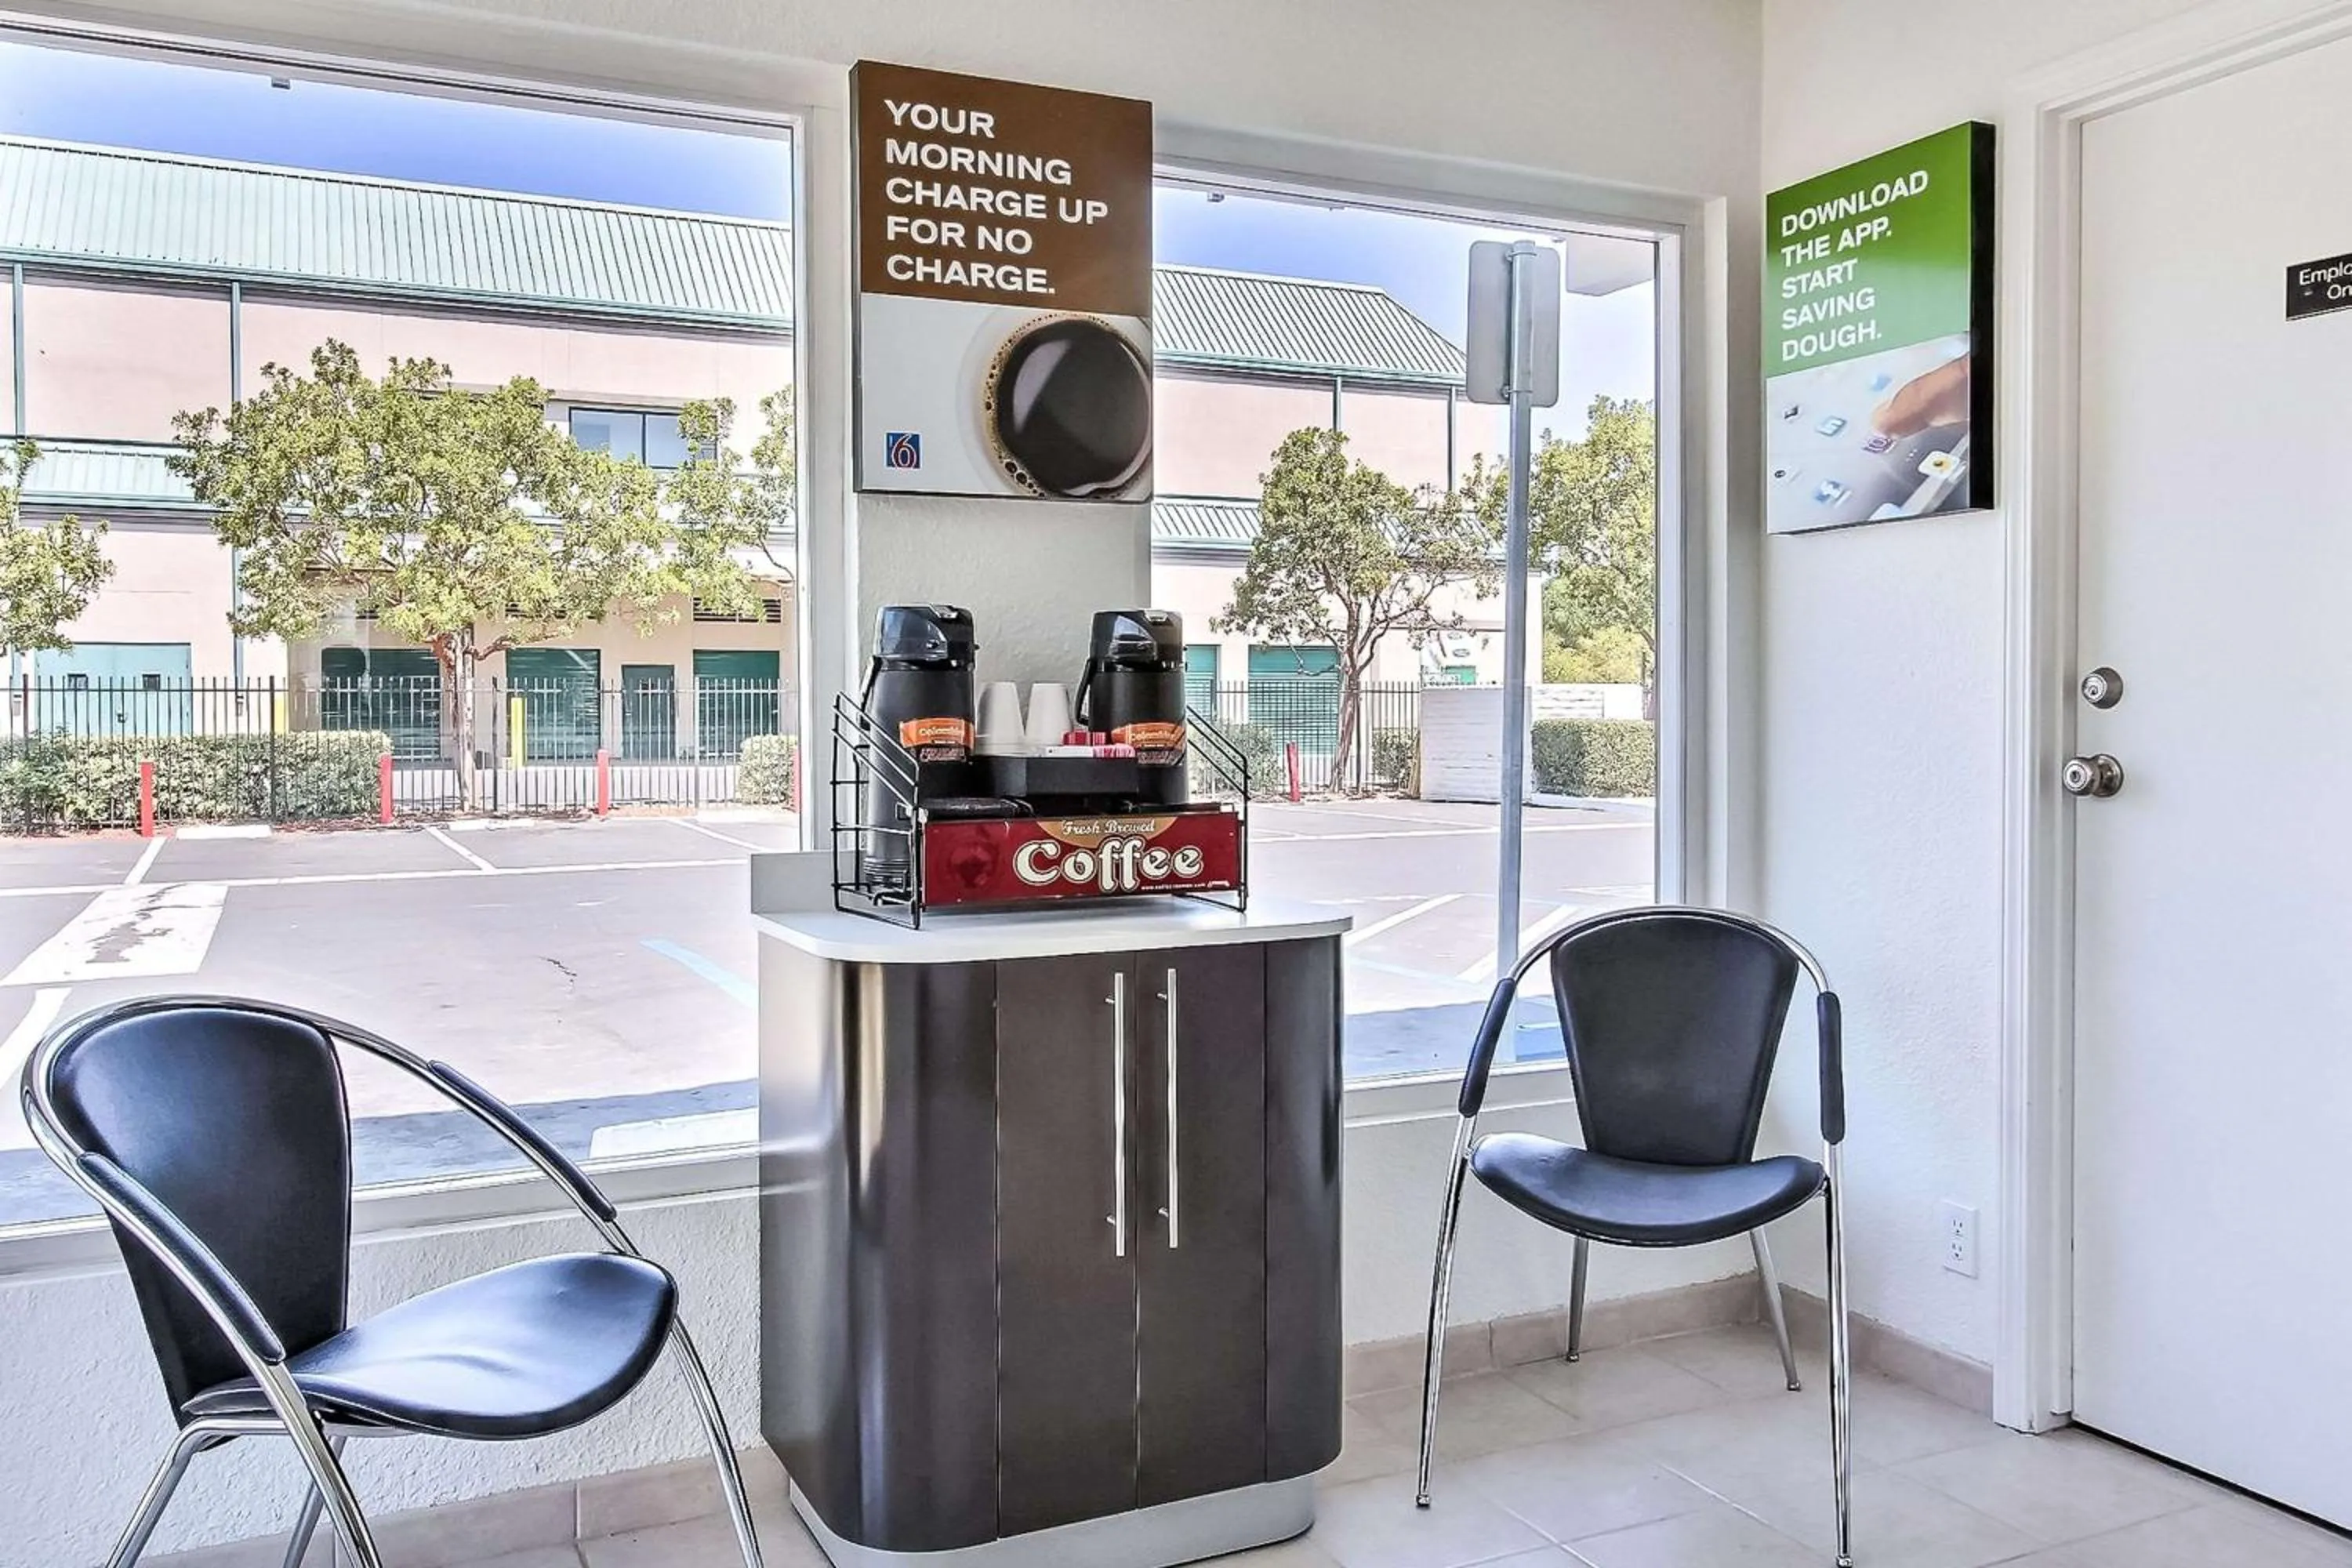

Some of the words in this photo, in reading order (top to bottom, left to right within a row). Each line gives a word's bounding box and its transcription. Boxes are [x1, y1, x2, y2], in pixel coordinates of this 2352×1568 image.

[884, 99, 995, 139] YOUR
[885, 138, 1072, 186] MORNING
[885, 176, 1047, 220] CHARGE
[1058, 197, 1109, 225] UP
[1781, 169, 1929, 237] DOWNLOAD
[887, 216, 966, 249] FOR
[977, 224, 1033, 255] NO
[1780, 234, 1831, 267] THE
[1837, 216, 1892, 252] APP.
[886, 253, 1055, 294] CHARGE.
[1781, 258, 1858, 299] START
[1781, 287, 1875, 330] SAVING
[1781, 318, 1882, 362] DOUGH.
[891, 433, 917, 470] 6
[1062, 818, 1100, 835] Fresh
[1105, 818, 1155, 833] Brewed
[1013, 835, 1203, 893] Coffee
